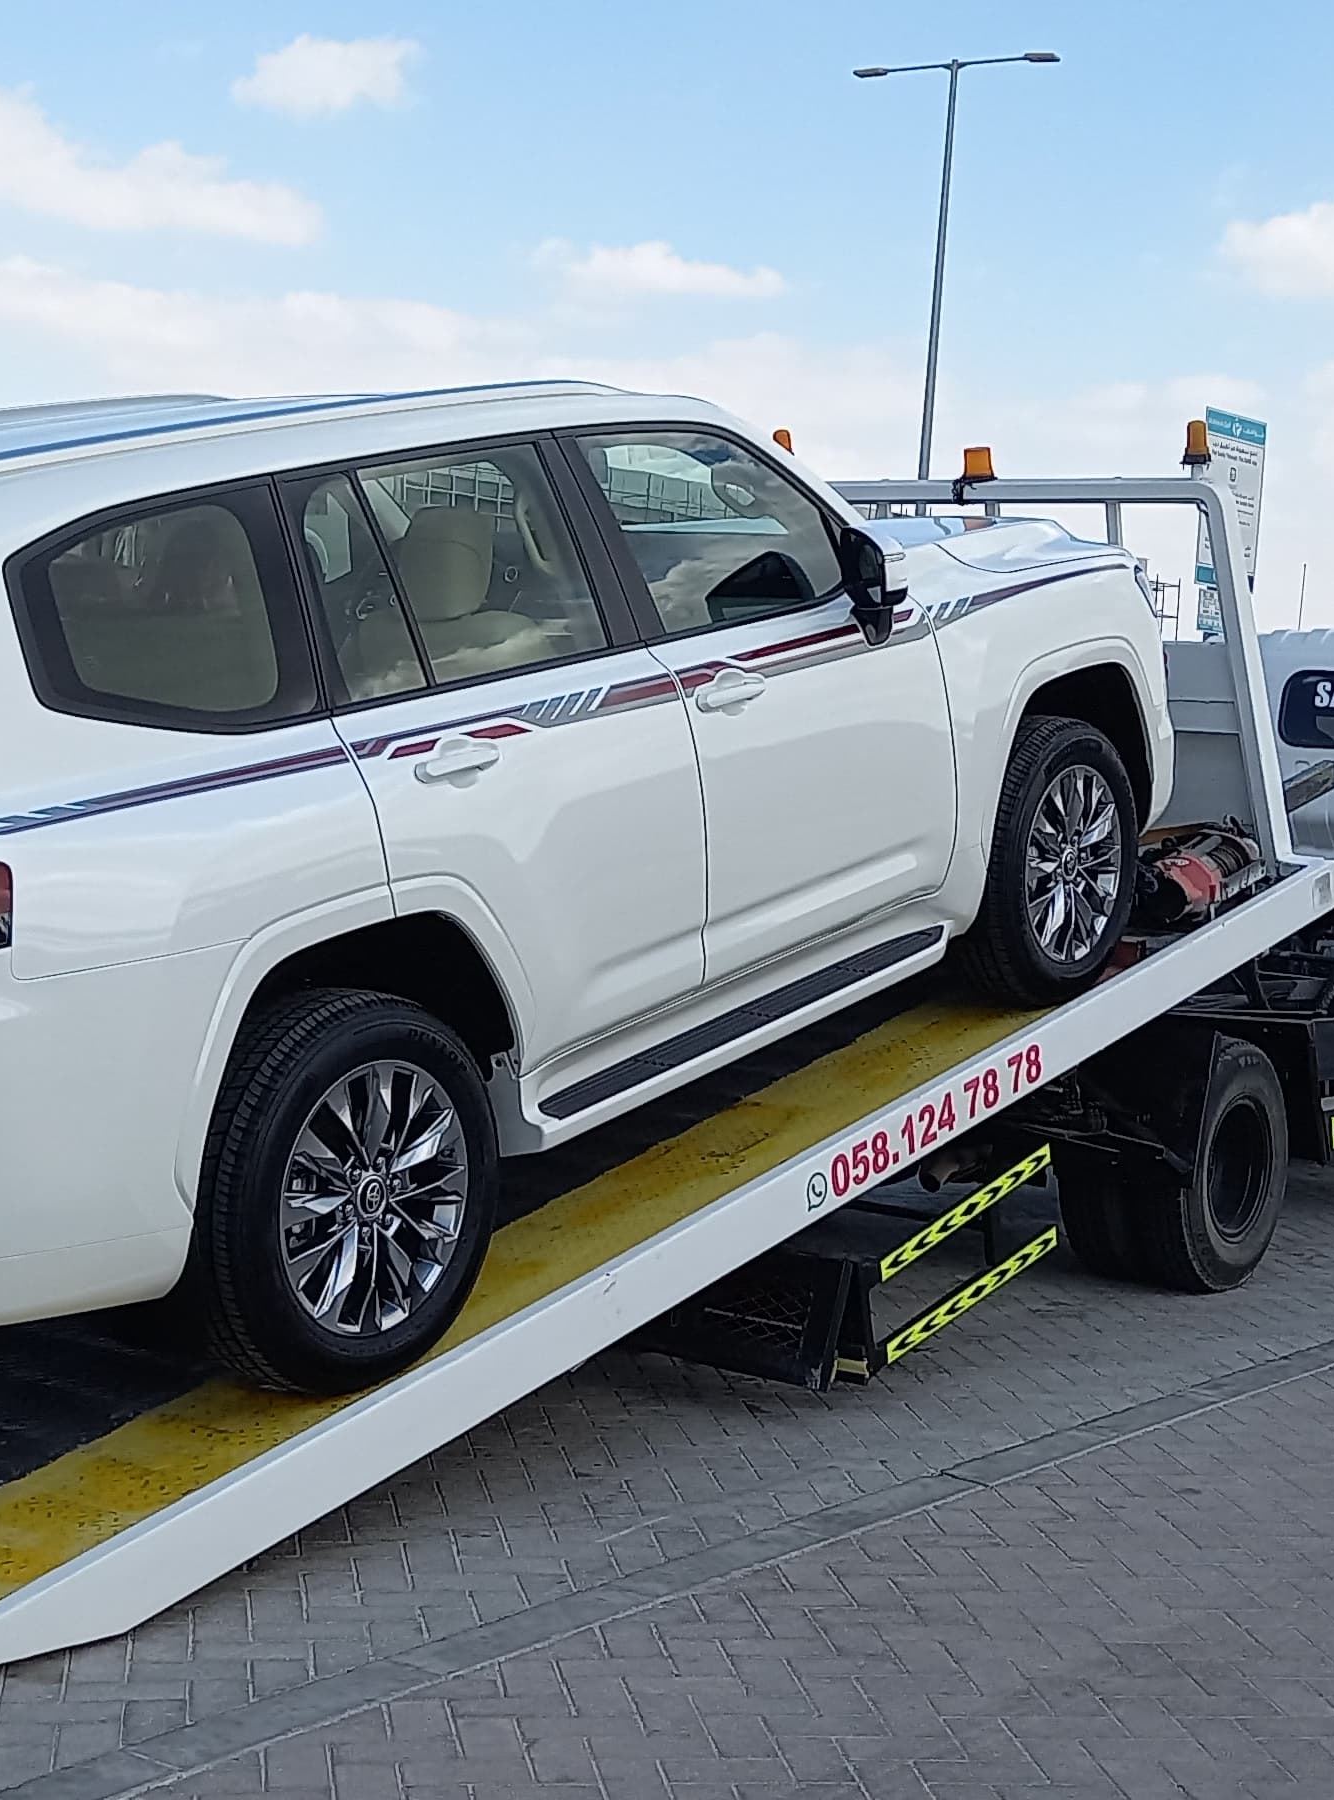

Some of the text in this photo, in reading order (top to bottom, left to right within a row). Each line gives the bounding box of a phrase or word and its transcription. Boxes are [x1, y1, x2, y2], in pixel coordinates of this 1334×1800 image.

[831, 1044, 1042, 1197] 058.124 78 78
